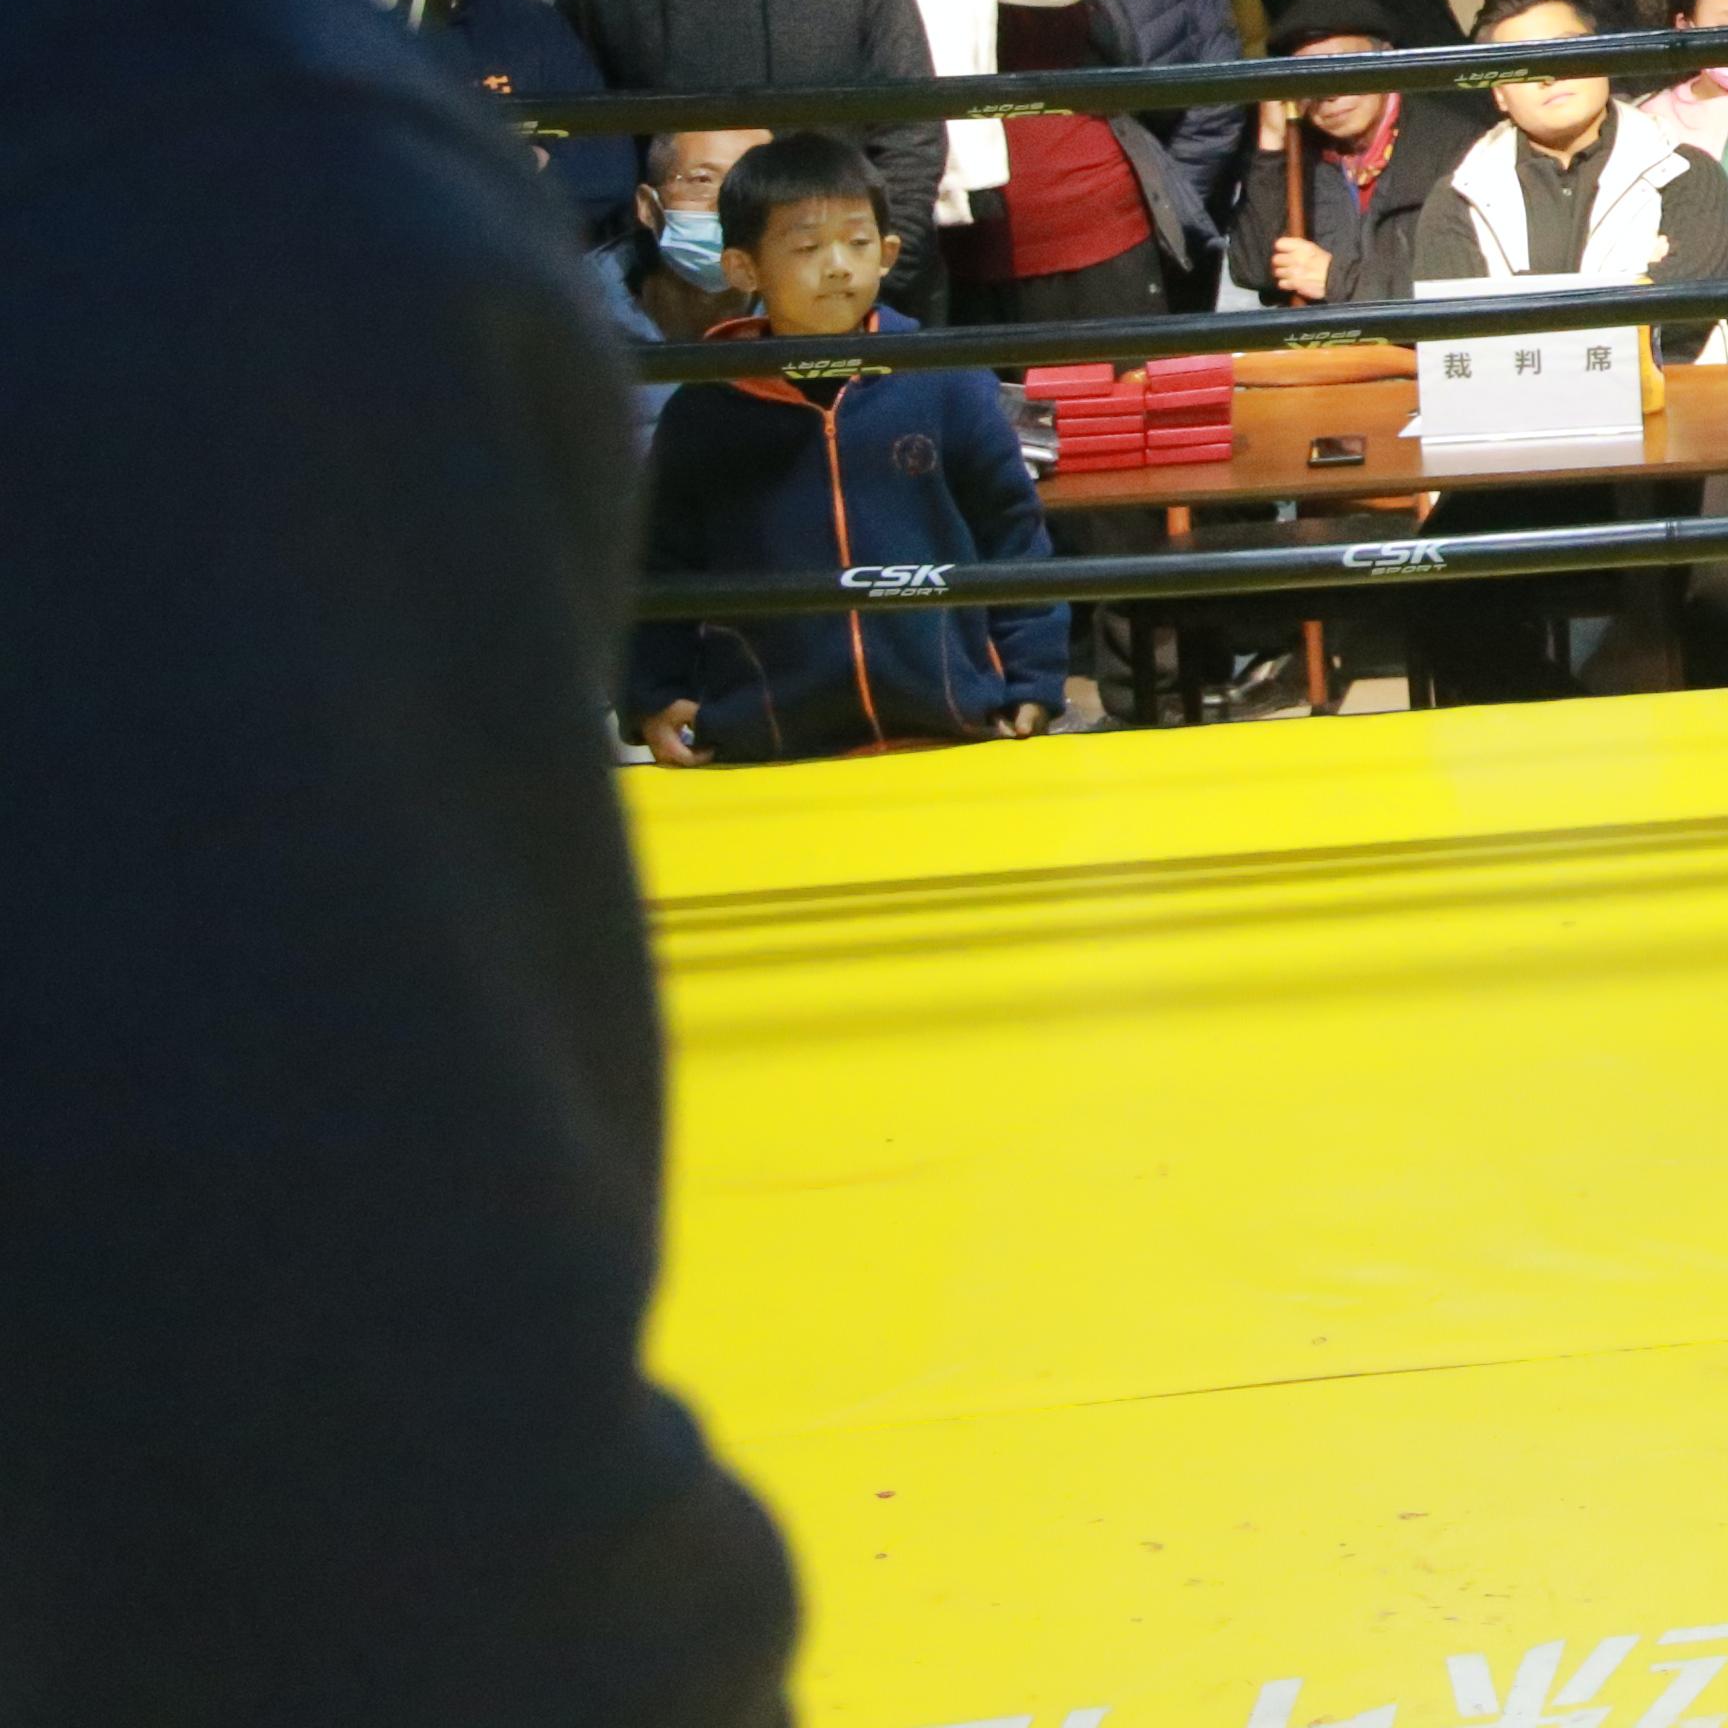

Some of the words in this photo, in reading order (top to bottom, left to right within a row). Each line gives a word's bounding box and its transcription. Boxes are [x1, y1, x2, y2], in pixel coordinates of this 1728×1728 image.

[1443, 345, 1612, 379] 裁判席
[1341, 541, 1453, 568] CSK
[840, 564, 956, 588] CSK
